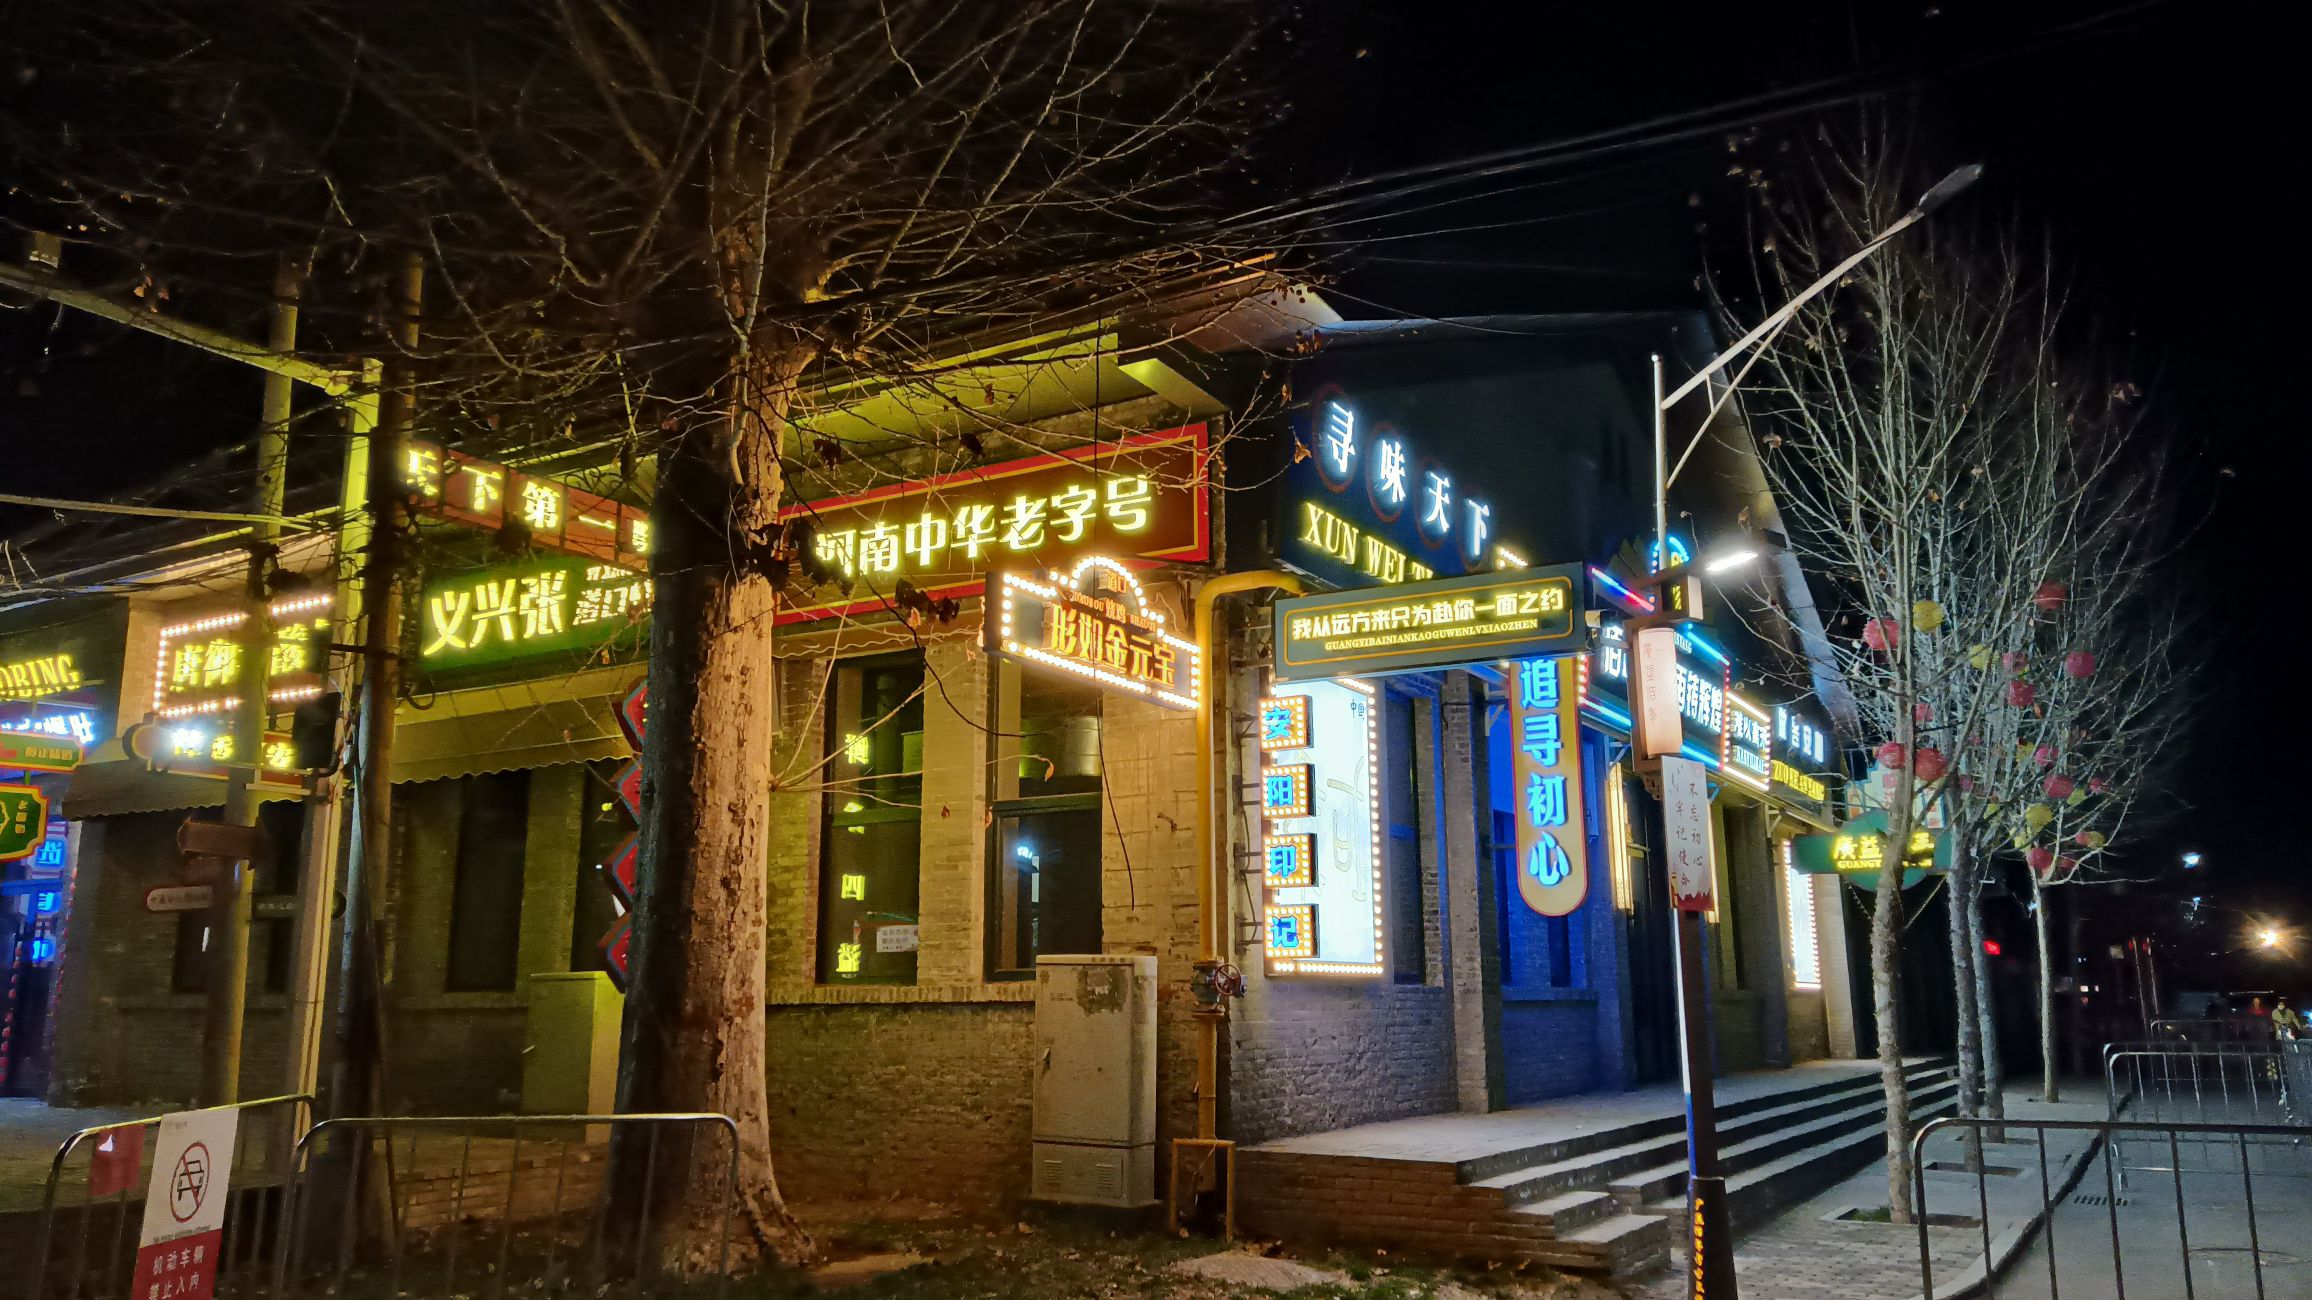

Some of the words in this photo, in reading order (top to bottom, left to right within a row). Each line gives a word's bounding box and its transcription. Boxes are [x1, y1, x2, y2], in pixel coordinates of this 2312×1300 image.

[1327, 401, 1490, 557] 寻味天下
[816, 474, 1151, 578] 河南中华老字号
[1304, 502, 1359, 565] XUN
[1366, 535, 1407, 583] WEI
[423, 570, 567, 656] 义兴张
[1050, 603, 1176, 689] 形如金元宝
[1291, 588, 1564, 641] 我从远方来只为赴你一面之约
[1324, 618, 1539, 651] GUANGYIBAINIANKAOGUWENLVXIAOZHEN
[1518, 658, 1571, 887] 追寻初心
[1263, 705, 1301, 950] 安阳印记
